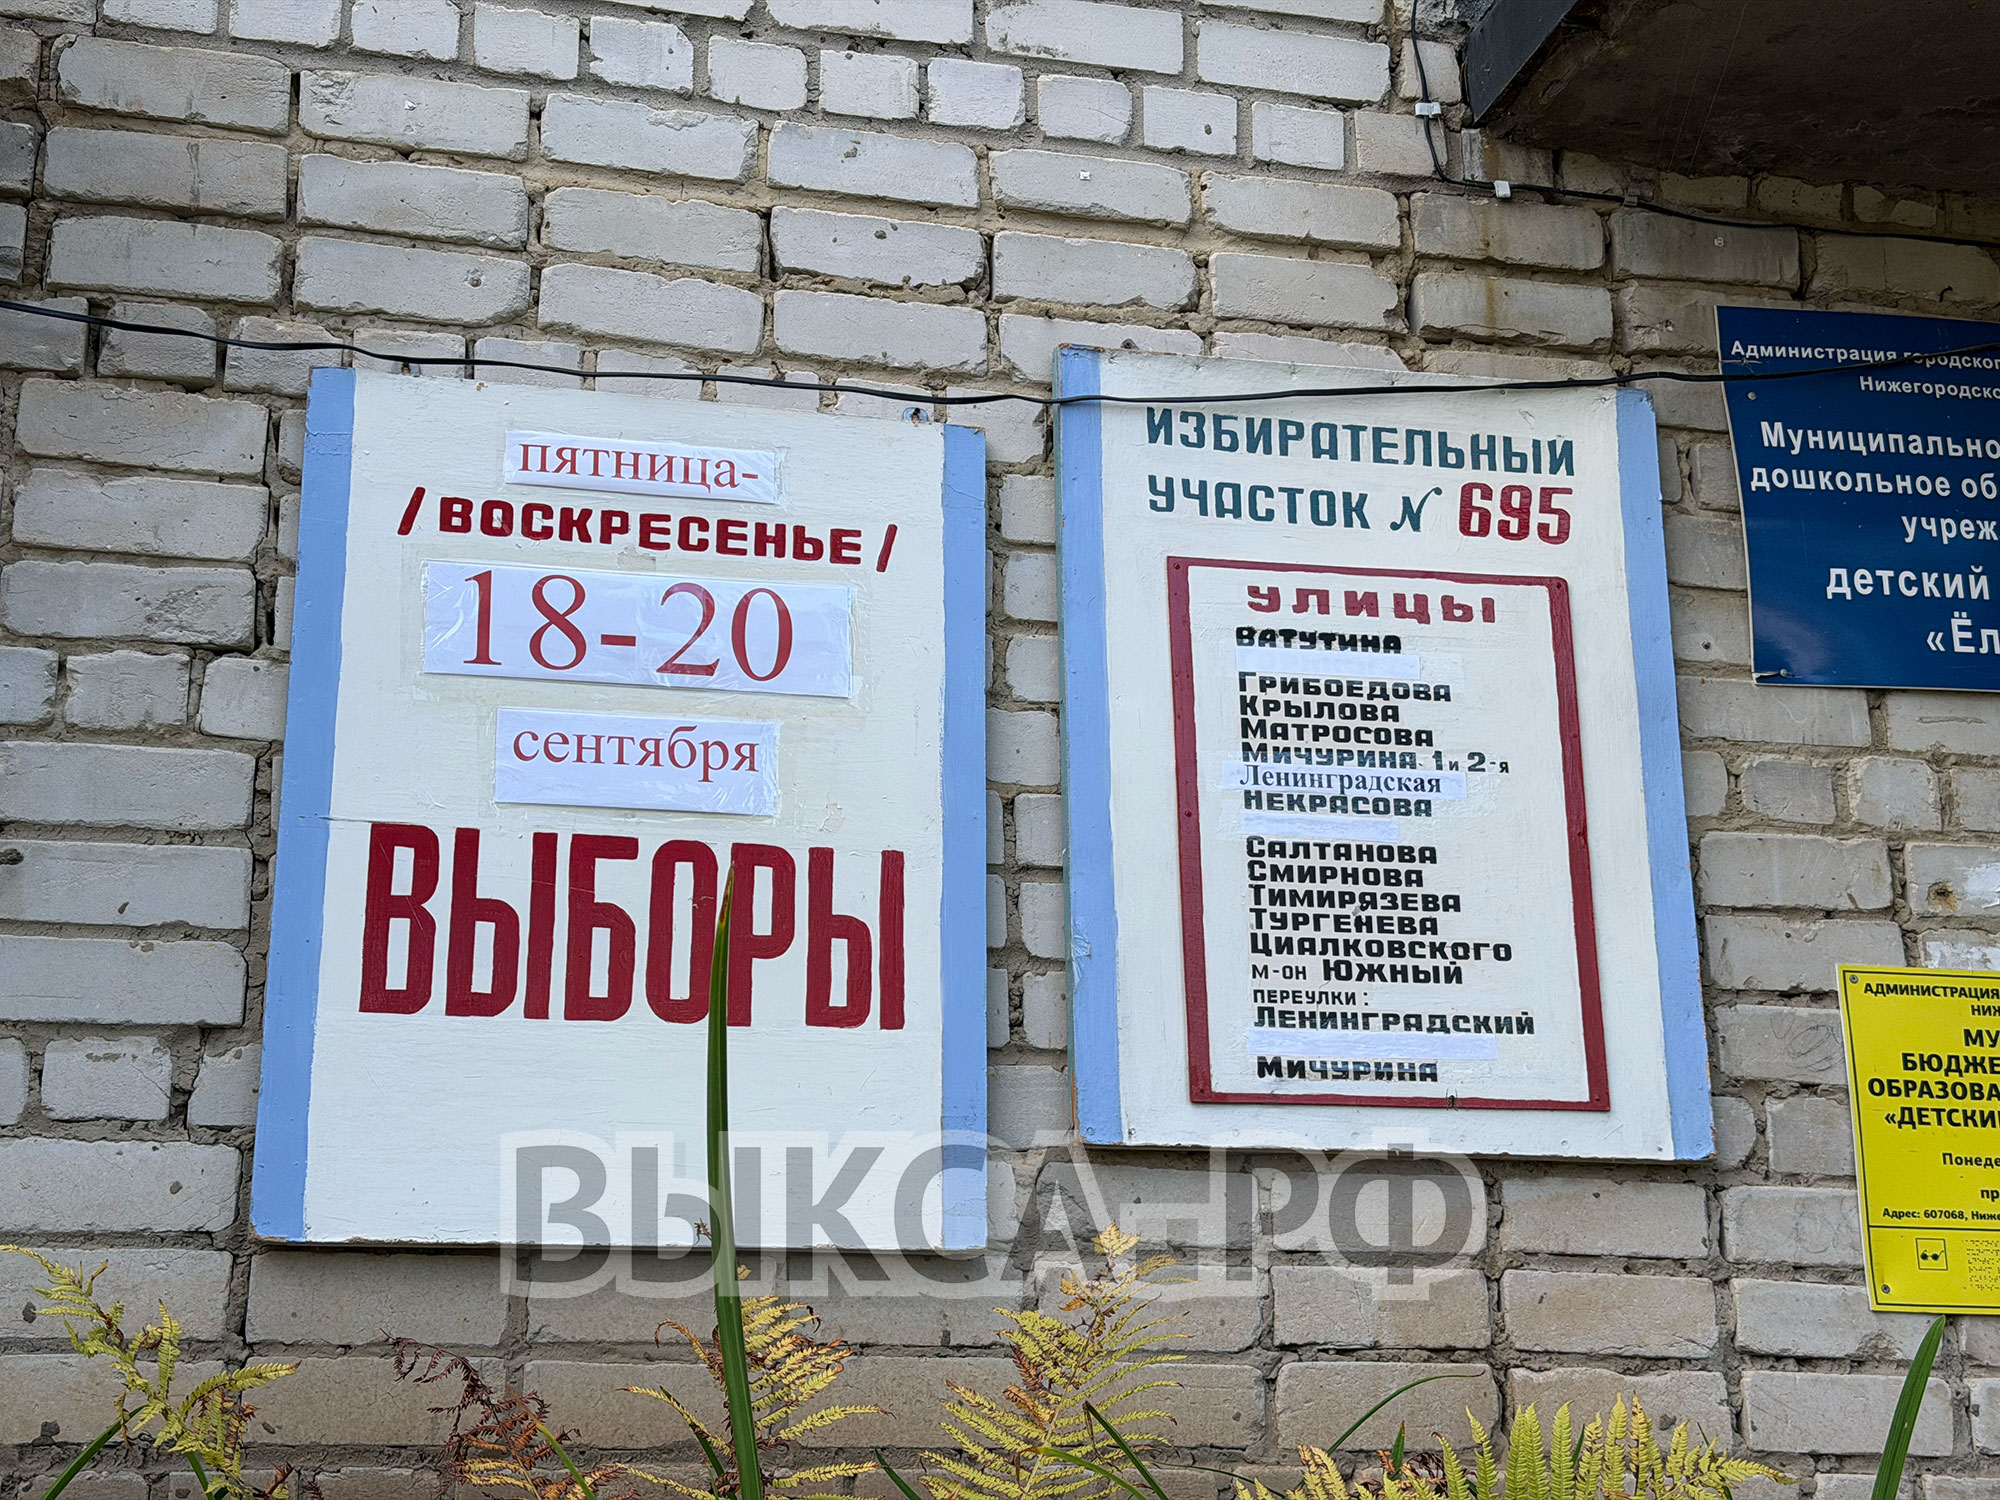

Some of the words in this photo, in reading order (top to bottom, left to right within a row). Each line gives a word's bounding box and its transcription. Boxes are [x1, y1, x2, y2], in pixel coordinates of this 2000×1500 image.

[1731, 340, 1897, 363] Администрация
[1859, 375, 2000, 400] Нижегородско
[1146, 406, 1575, 477] ИЗБИРАТЕЛЬНЫЙ
[1760, 420, 2000, 460] Муниципально
[519, 443, 760, 491] пятница-
[1751, 467, 1951, 497] дошкольное
[1148, 474, 1370, 529] УЧАСТОК
[1459, 482, 1574, 546] 695
[1901, 516, 2000, 545] учреж
[1826, 564, 1990, 601] детский
[1247, 585, 1497, 625] УЛИЦЫ
[463, 569, 794, 683] 18-20
[1236, 626, 1402, 654] ВАТУТИНА
[512, 725, 760, 783] сентября
[1239, 764, 1442, 795] Ленинградская
[1243, 789, 1432, 817] НЕКРАСОВА
[358, 822, 905, 1030] ВЫБОРЫ
[1322, 959, 1463, 985] ЮЖНЫЙ
[1864, 983, 2000, 1001] АДМИНИСТРАЦИЯ
[1902, 1053, 2000, 1077] БЮДЖЕ
[1868, 1078, 2000, 1101] ОБРАЗОВА
[1884, 1107, 2000, 1130] «ДЕТСКИ
[1882, 1208, 1920, 1220] Адрес:
[1924, 1210, 1968, 1222] 607068,
